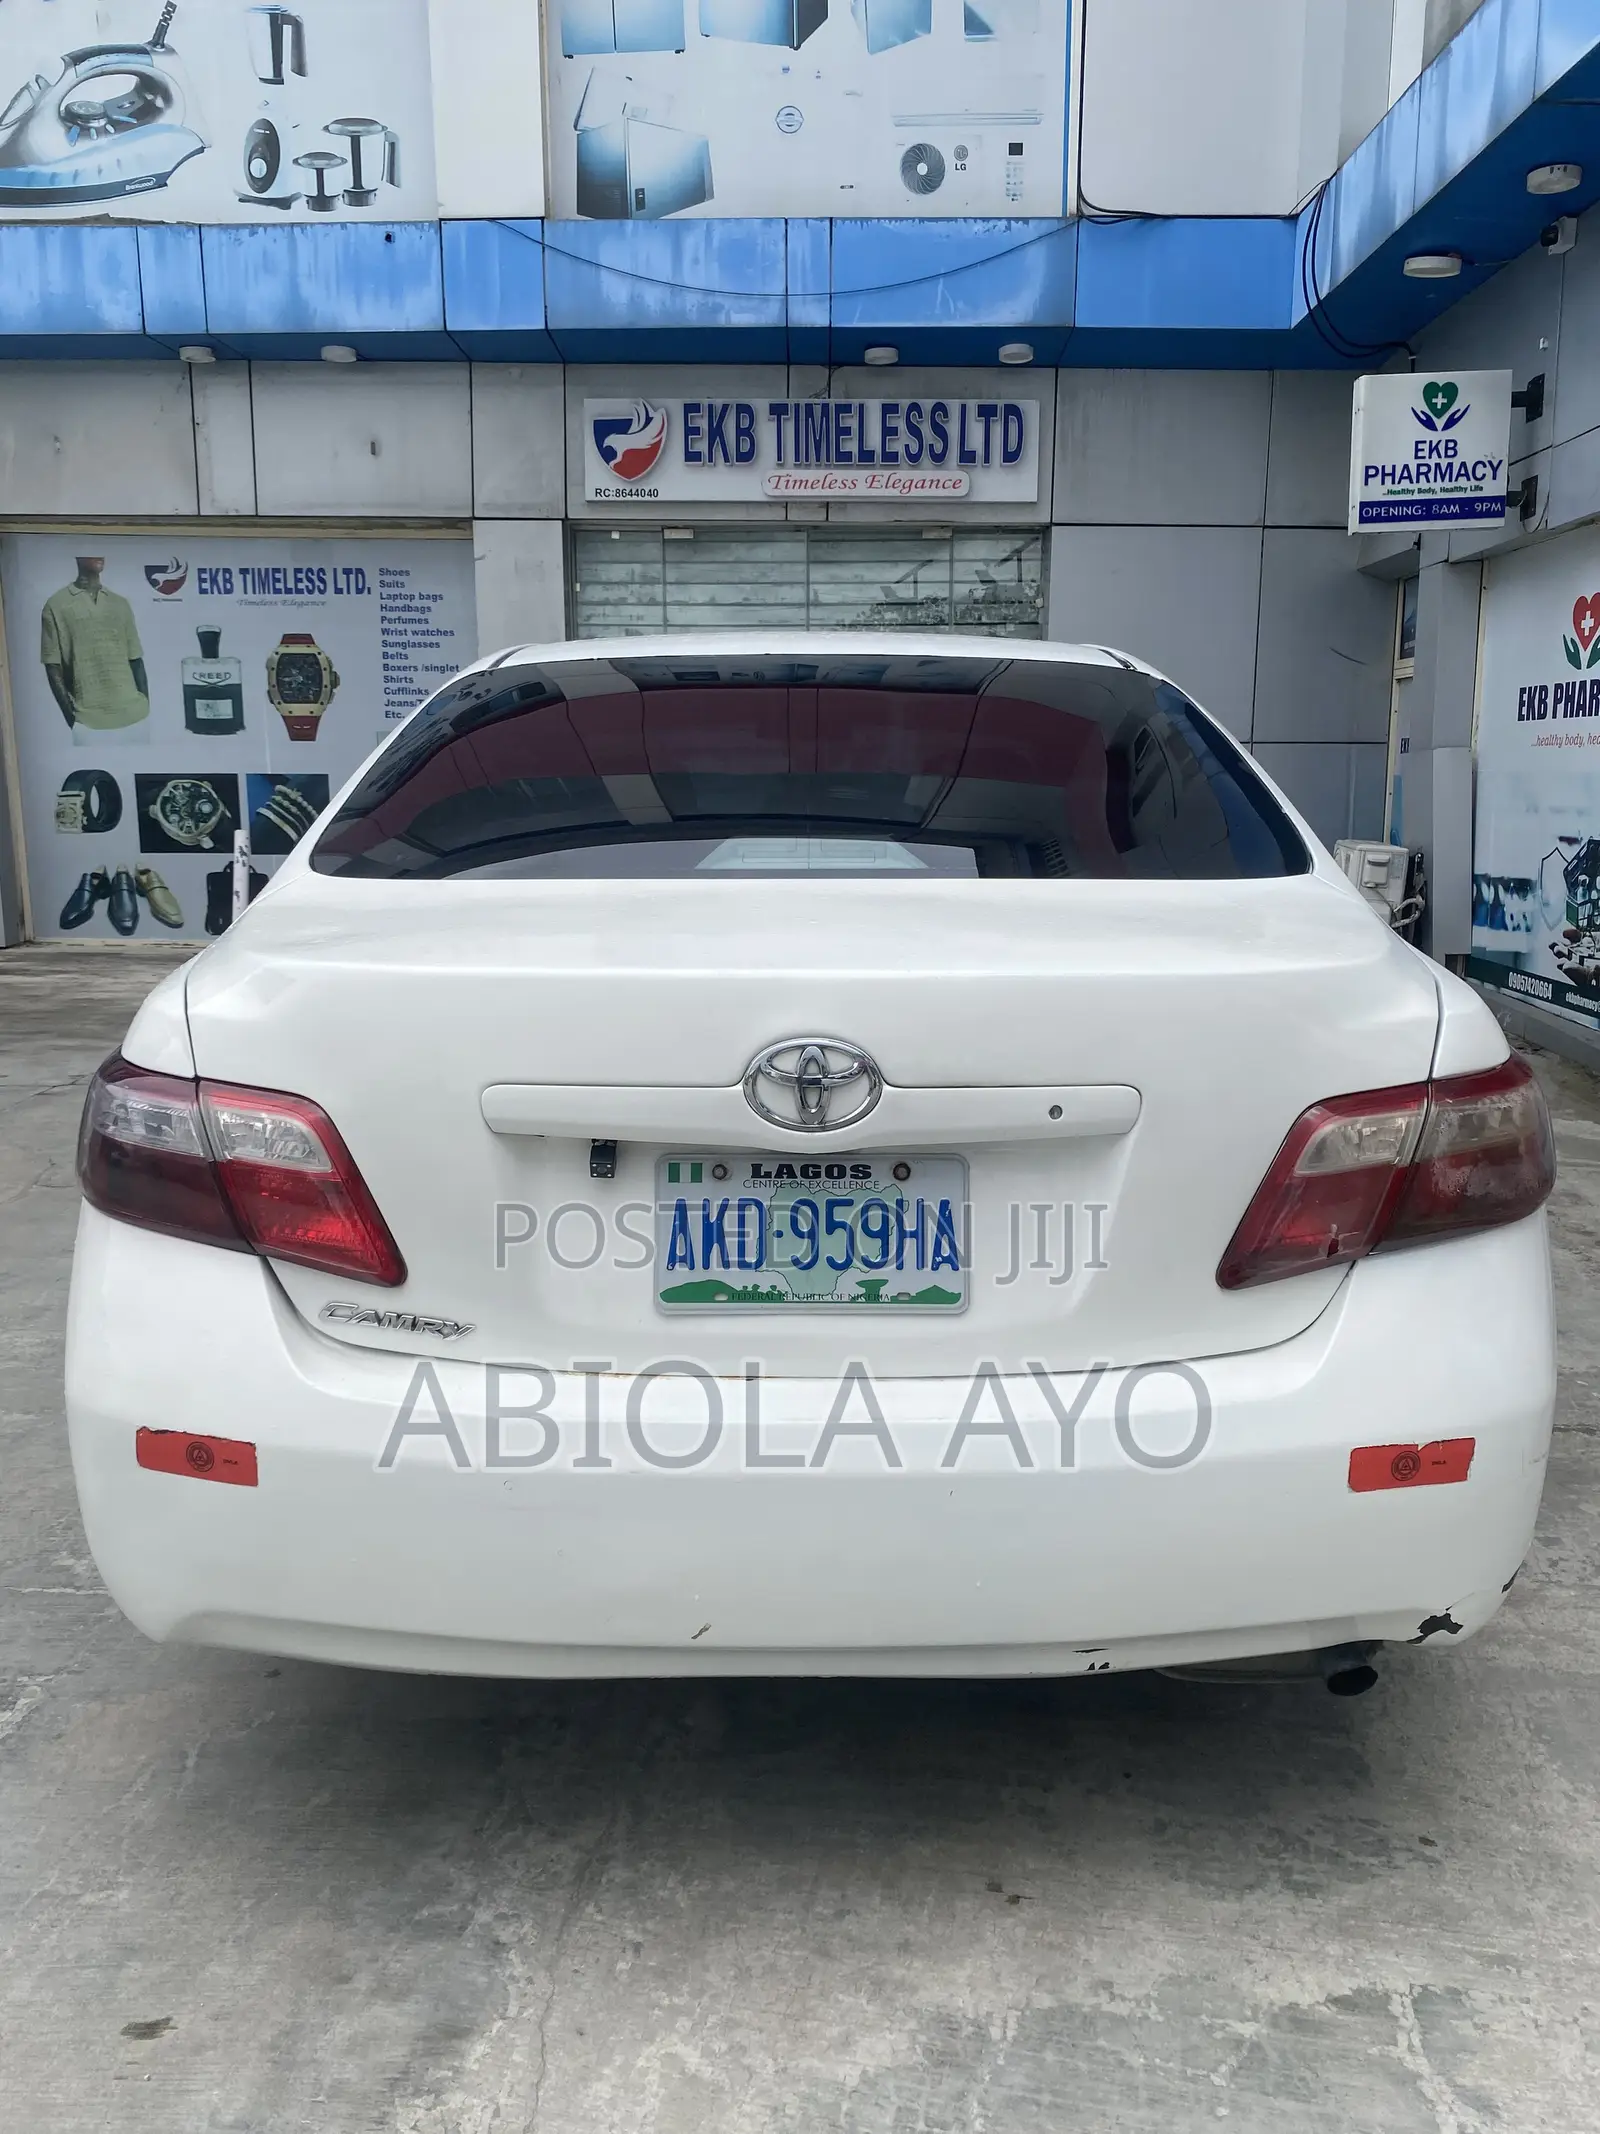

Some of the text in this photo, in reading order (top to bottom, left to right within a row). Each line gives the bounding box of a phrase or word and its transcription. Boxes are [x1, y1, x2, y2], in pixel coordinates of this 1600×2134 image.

[954, 163, 967, 171] LG
[683, 401, 1025, 465] EKB TIMELESS LTD
[1414, 439, 1458, 460] EKB
[1364, 459, 1504, 487] PHARMACY
[767, 473, 963, 494] Timeless Elegance
[595, 487, 659, 498] RC:8644040
[1417, 486, 1438, 495] Body,
[1440, 485, 1468, 494] Healthy
[1470, 484, 1484, 492] Life
[1362, 504, 1427, 518] OPENING:
[1431, 503, 1460, 515] 8AM
[1474, 502, 1502, 513] 9PM
[378, 567, 411, 577] Shoes
[197, 567, 372, 596] EKB TIMELESS LTD.
[379, 579, 406, 588] Suits
[380, 591, 444, 602] Laptop bags
[380, 603, 432, 614] Handbags
[380, 615, 430, 624] Perfumes
[381, 627, 455, 637] Wrist watches
[381, 639, 441, 650] Sunglasses
[382, 651, 409, 660] Belts
[382, 663, 418, 672] Boxers
[383, 675, 414, 684] Shirts
[384, 686, 430, 696] Cufflinks
[1517, 684, 1549, 722] EKB
[384, 710, 406, 719] Etc.
[1565, 732, 1585, 748] body,
[1508, 971, 1553, 1000] 09057420664
[750, 1163, 872, 1180] LAGOS
[742, 1179, 880, 1190] CENTRE OF EXCELLENCE
[318, 1301, 476, 1341] CAMRY
